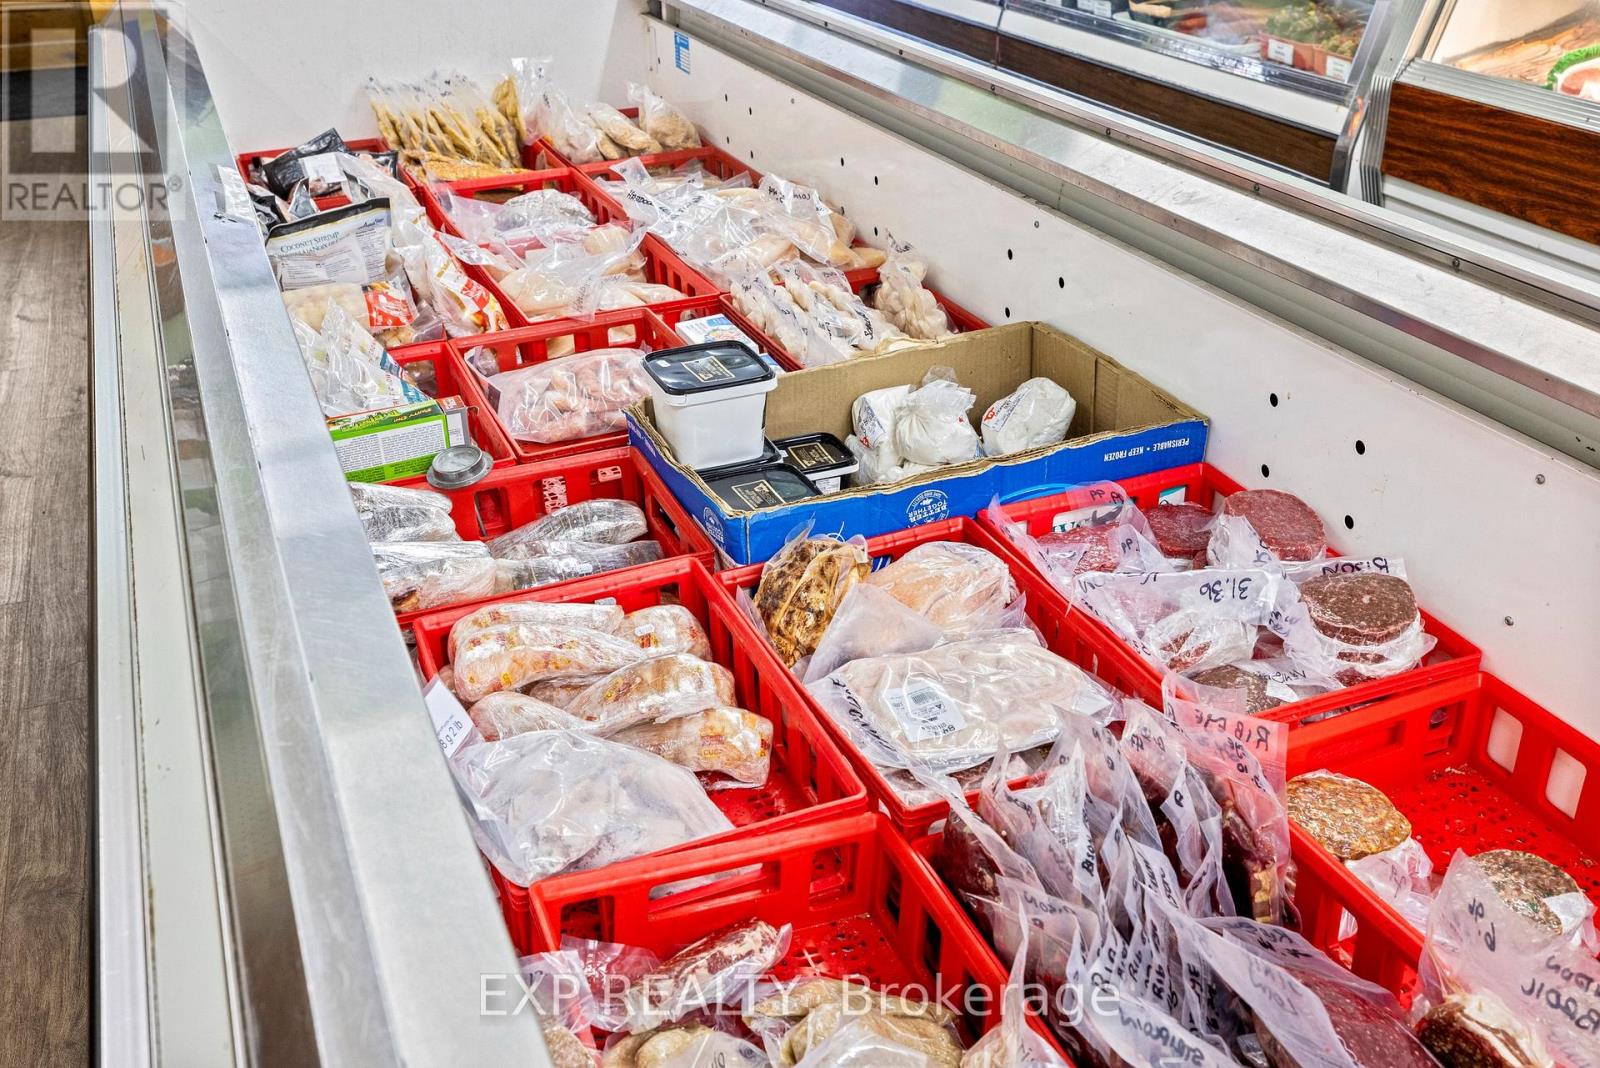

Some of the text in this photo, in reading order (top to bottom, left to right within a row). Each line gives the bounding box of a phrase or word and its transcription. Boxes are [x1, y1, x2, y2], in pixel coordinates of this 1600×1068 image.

[1103, 437, 1190, 463] PERISHABLE KEEP FROZEN
